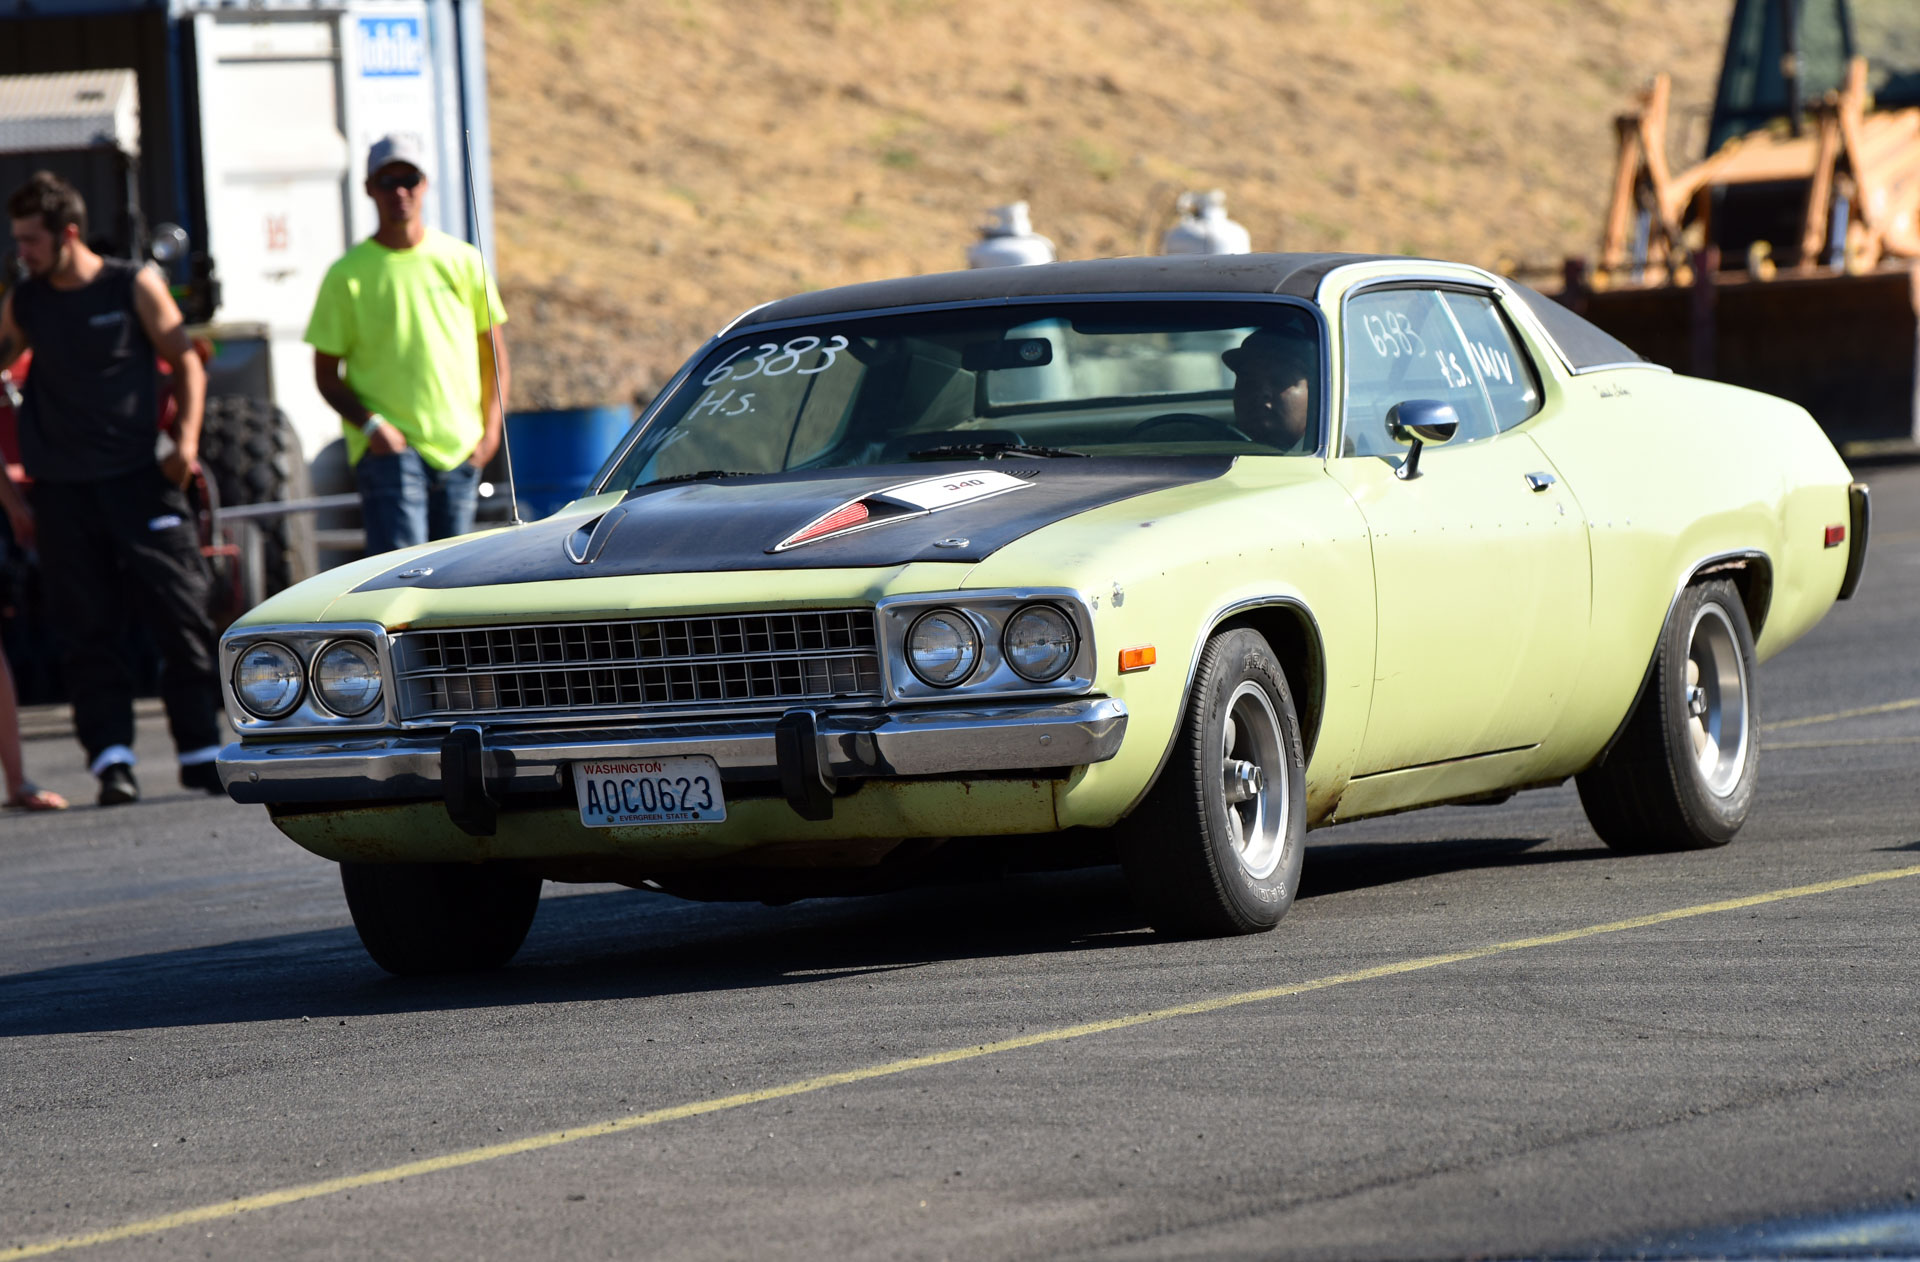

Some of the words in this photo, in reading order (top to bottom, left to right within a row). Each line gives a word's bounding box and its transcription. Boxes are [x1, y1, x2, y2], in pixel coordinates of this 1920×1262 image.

[1363, 310, 1426, 358] 6383
[702, 335, 849, 386] 6383
[688, 388, 756, 420] H.S.
[943, 479, 985, 491] 340
[1243, 652, 1288, 702] GRAND
[584, 762, 662, 775] WASHINGTON
[619, 814, 663, 822] EVERGREEN
[665, 812, 689, 820] STATE
